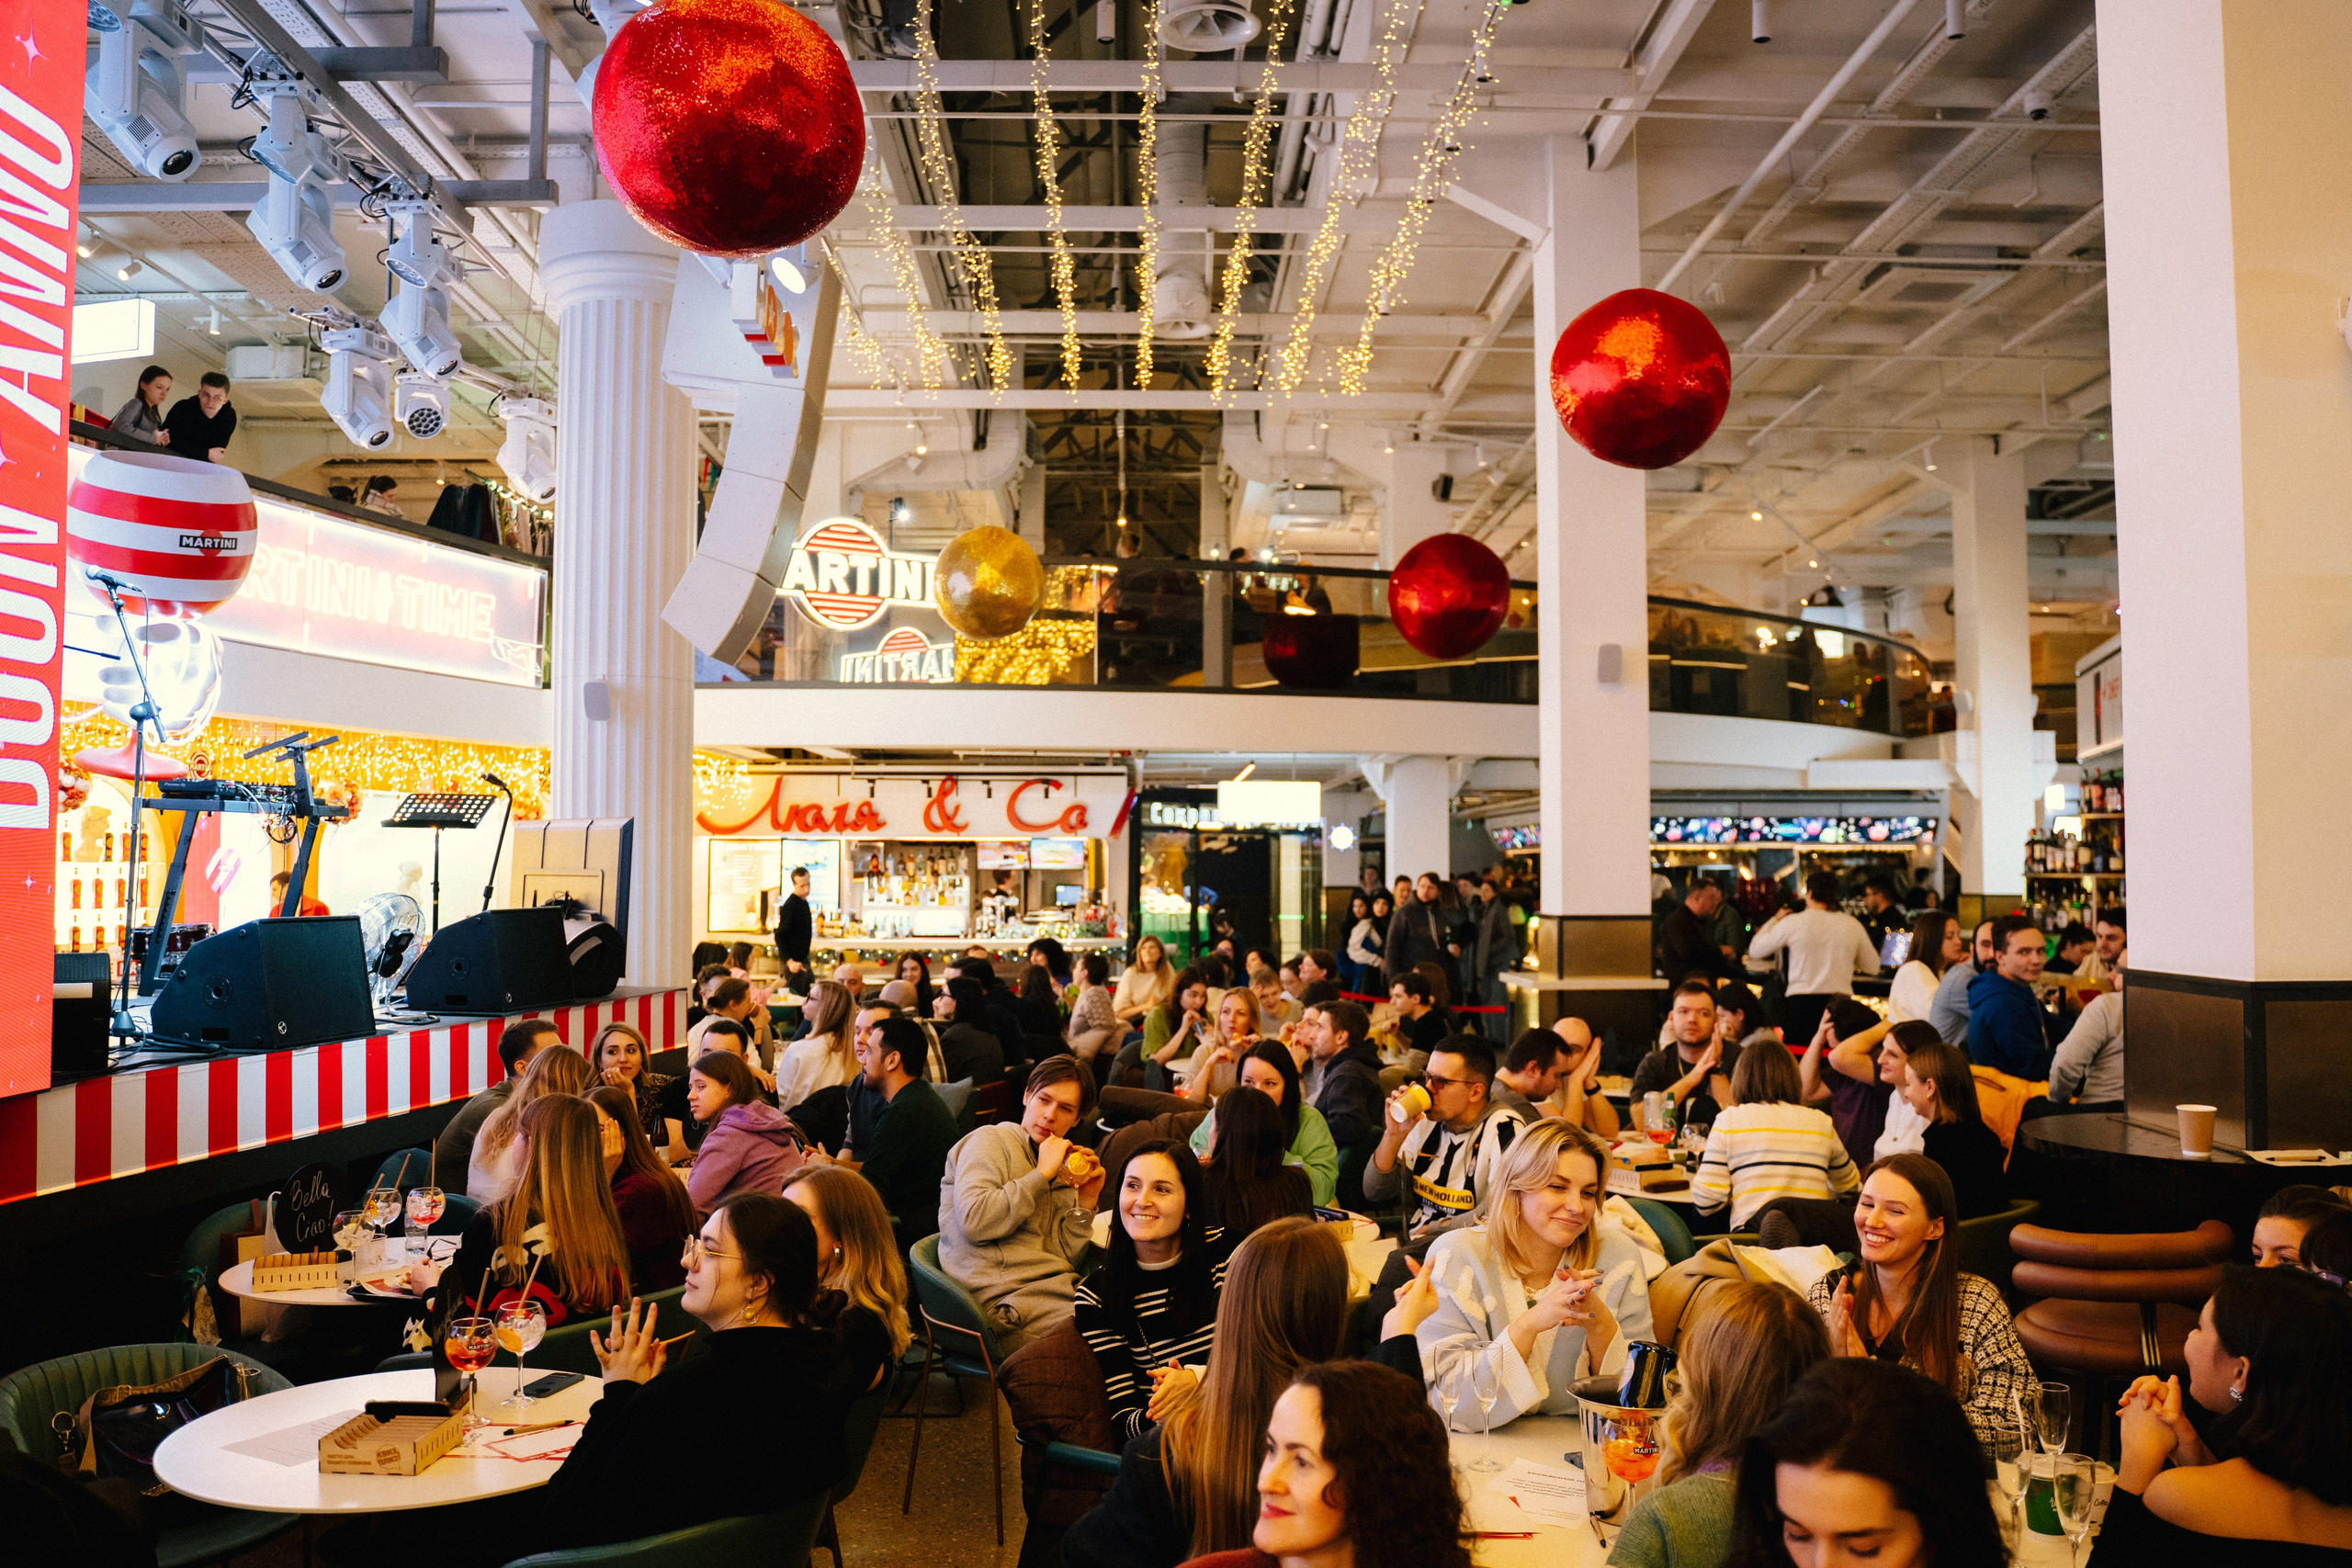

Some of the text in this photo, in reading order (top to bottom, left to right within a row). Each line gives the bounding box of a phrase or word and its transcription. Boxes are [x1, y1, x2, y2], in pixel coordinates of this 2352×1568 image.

[182, 536, 236, 549] MARTINI
[782, 548, 936, 603] ARTINI
[923, 775, 969, 833] &
[290, 1170, 332, 1212] Bella
[1419, 1184, 1473, 1204] NEW HOLLAND
[296, 1200, 334, 1242] Ciao!
[469, 1342, 492, 1350] MARTINI
